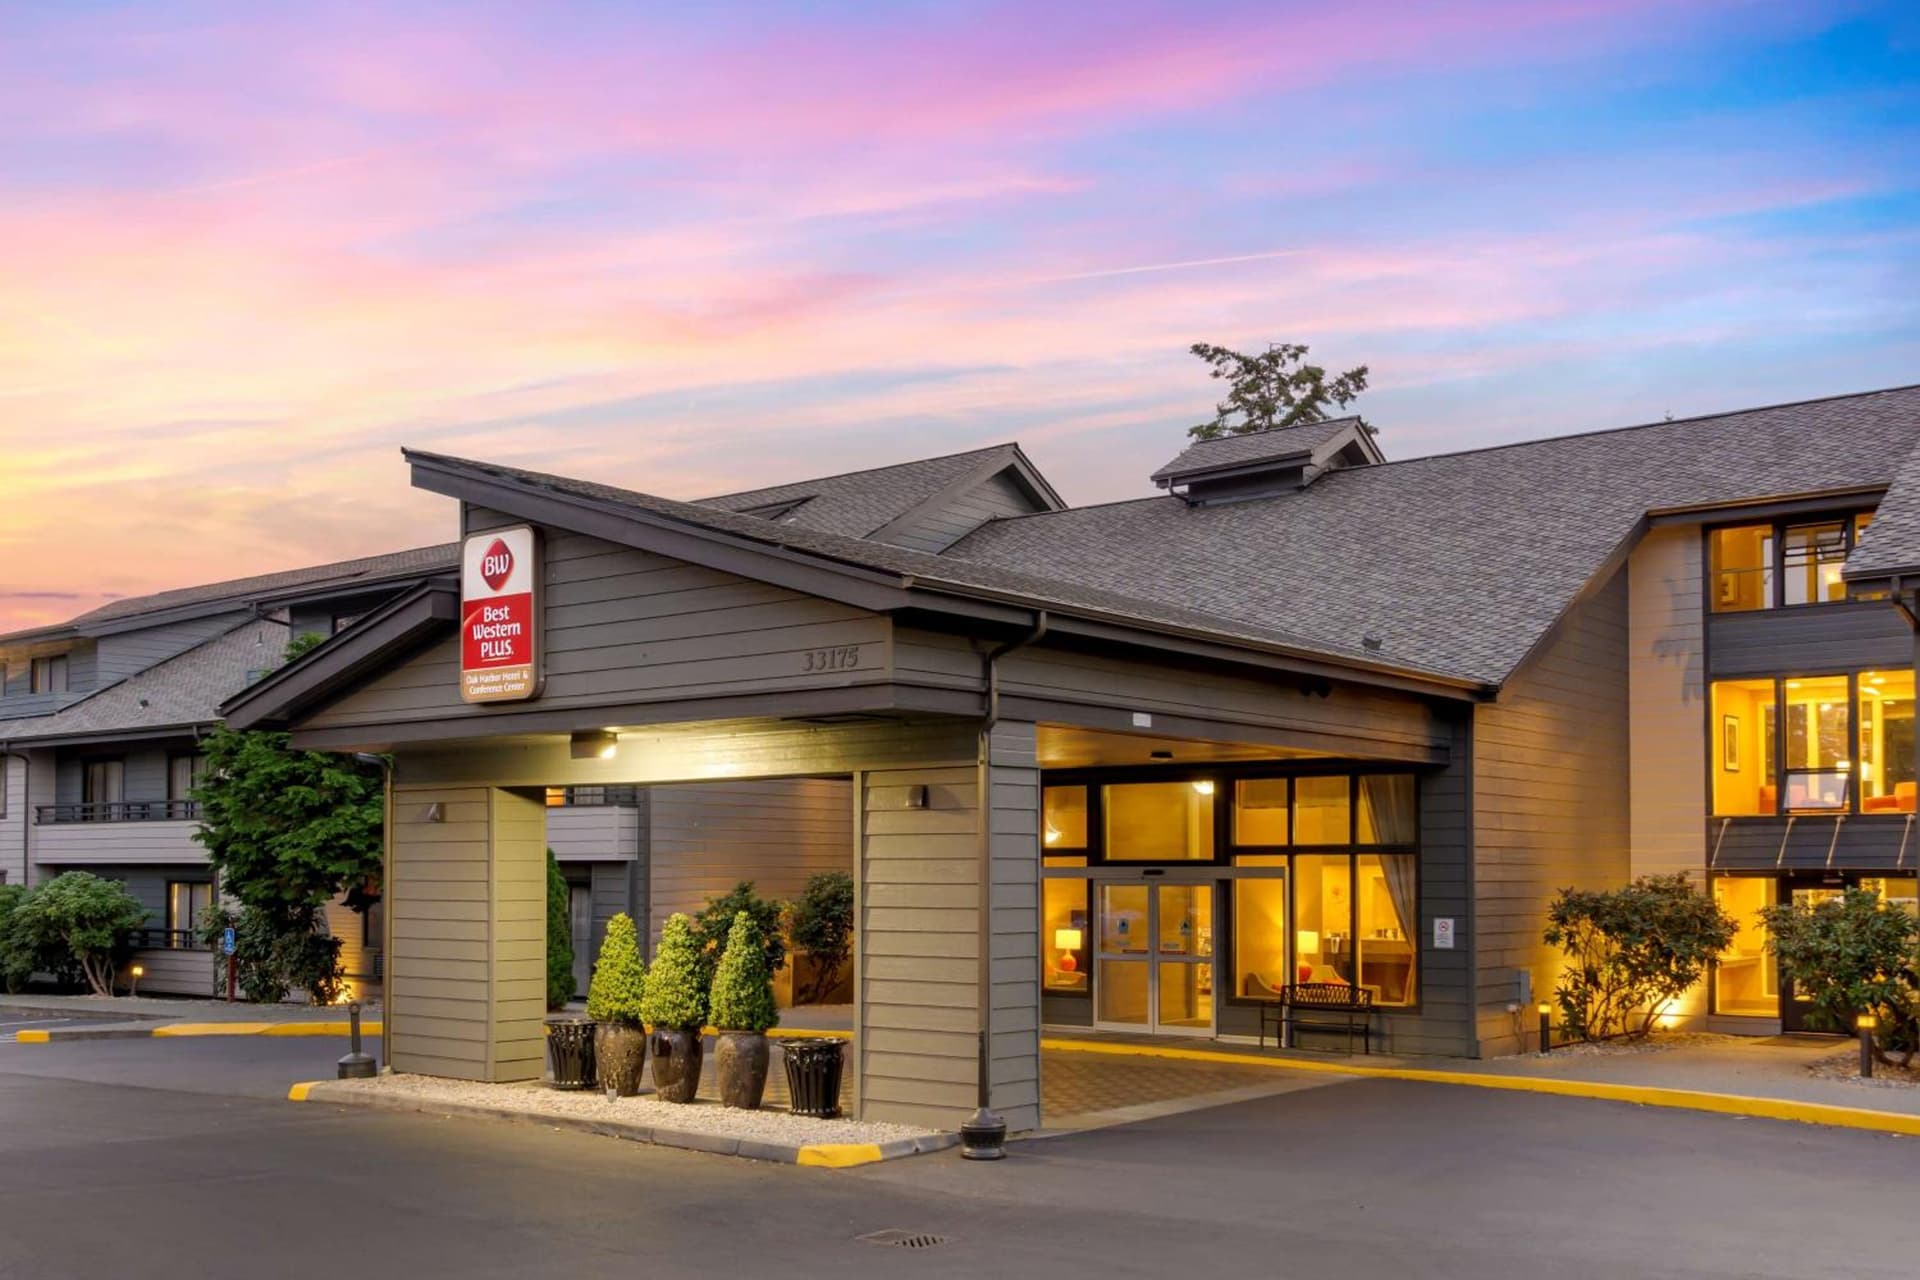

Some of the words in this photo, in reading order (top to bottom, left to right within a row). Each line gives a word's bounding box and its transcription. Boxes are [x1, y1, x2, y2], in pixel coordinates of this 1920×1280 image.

[484, 553, 509, 577] BW
[483, 605, 510, 623] Best
[472, 622, 521, 641] Western
[801, 646, 859, 672] 33175
[466, 675, 478, 684] Oak
[469, 684, 503, 695] Conference
[503, 682, 526, 692] Center
